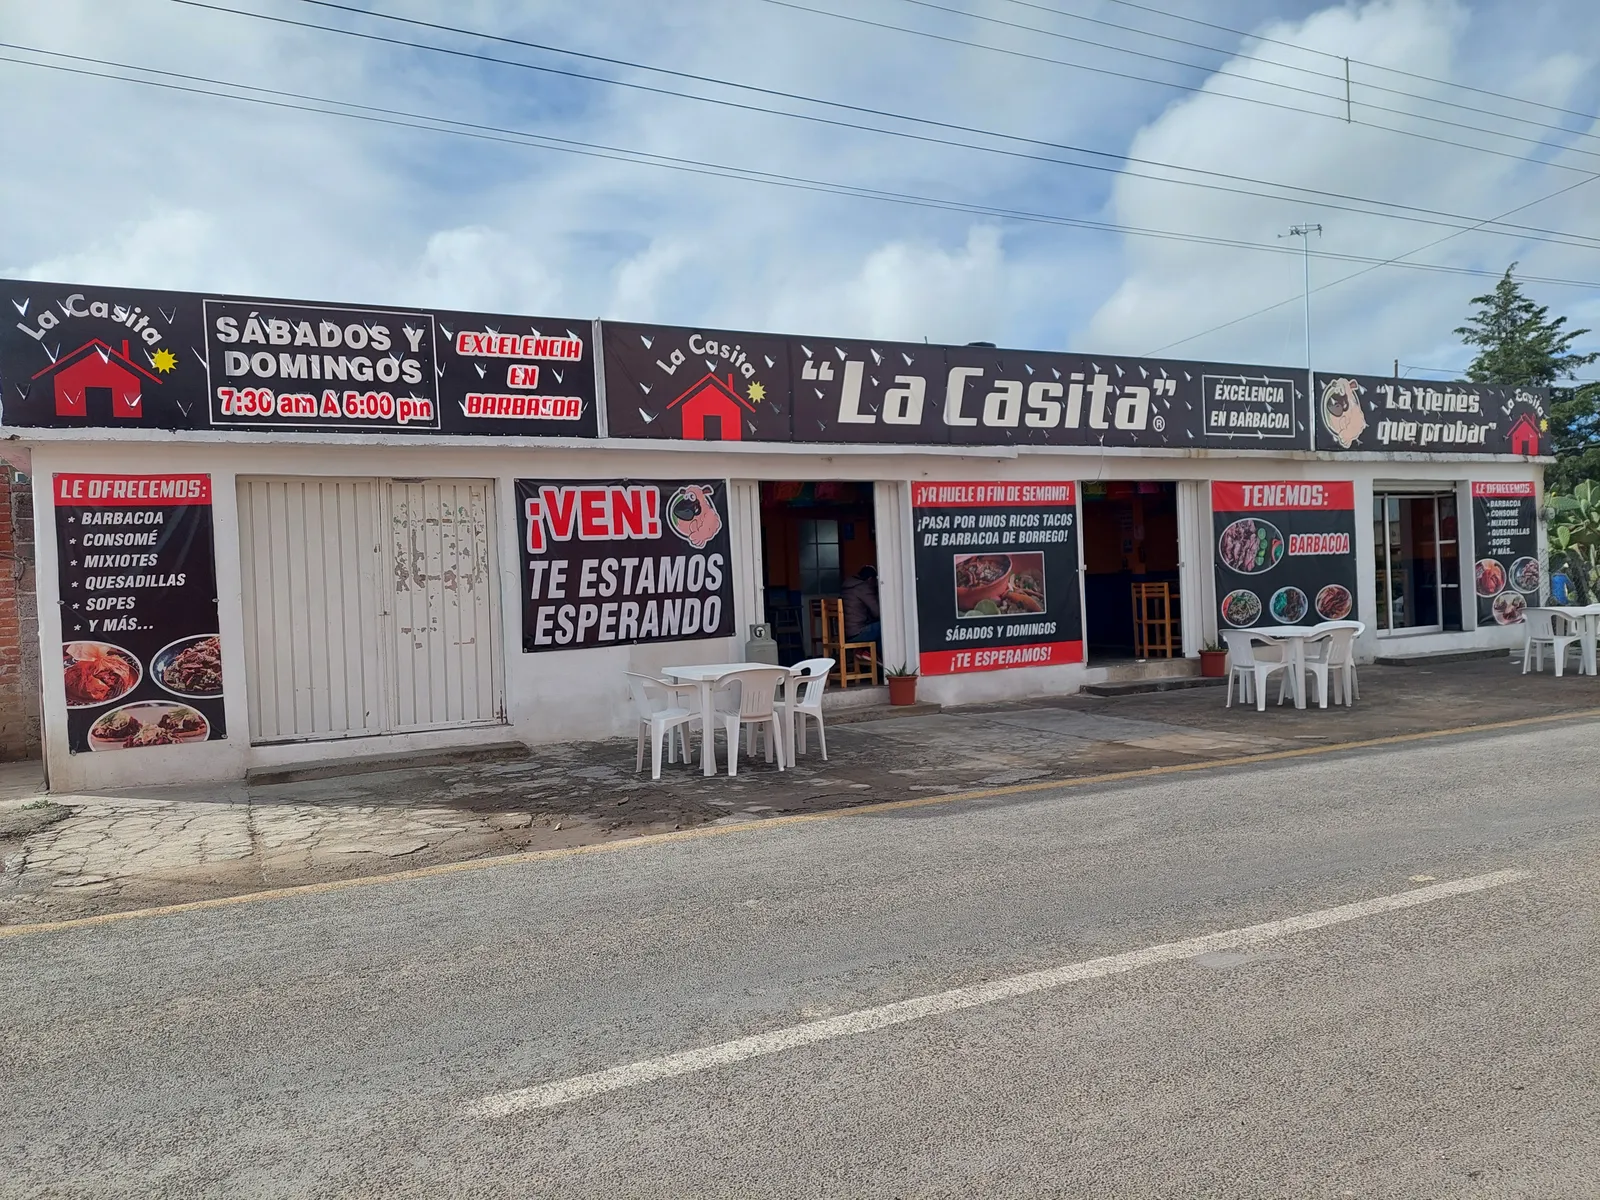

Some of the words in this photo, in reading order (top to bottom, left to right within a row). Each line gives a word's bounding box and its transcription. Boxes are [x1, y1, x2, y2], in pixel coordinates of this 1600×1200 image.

[16, 310, 60, 341] La
[65, 293, 163, 346] Casita
[216, 312, 392, 351] SÁBADOS
[402, 327, 425, 353] Y
[656, 349, 686, 375] La
[689, 334, 756, 379] Casita
[224, 350, 423, 384] DOMINGOS
[508, 366, 538, 387] EN
[1215, 384, 1284, 403] EXCELENCIA
[1416, 387, 1480, 413] tienes
[219, 388, 273, 415] 7:30
[279, 394, 316, 415] am
[321, 390, 340, 416] A
[398, 399, 432, 422] pm
[466, 394, 580, 418] BARBACOA
[1501, 398, 1515, 416] La
[1210, 411, 1227, 426] EN
[1229, 411, 1290, 429] BARBACOA
[1377, 421, 1417, 445] que
[61, 480, 85, 498] LE
[88, 479, 206, 498] OFRECEMOS:
[917, 486, 937, 505] ¡YA
[939, 486, 975, 502] HUELE
[976, 486, 985, 502] A
[987, 486, 1005, 501] FIN
[1007, 486, 1021, 501] DE
[1022, 485, 1070, 501] SEMANA!
[1242, 484, 1329, 507] TENEMOS:
[1476, 483, 1485, 494] LE
[82, 511, 164, 525] BARBACOA
[527, 488, 660, 551] ¡VEN!
[1491, 508, 1519, 517] CONSOMÉ
[917, 515, 950, 532] ¡PASA
[953, 515, 975, 529] POR
[978, 514, 1006, 528] UNOS
[1009, 514, 1040, 527] RICOS
[1042, 513, 1073, 527] TACOS
[1491, 519, 1518, 527] MIXIOTES
[1491, 528, 1530, 536] QUESADILLAS
[83, 529, 158, 547] CONSOMÉ
[924, 533, 939, 547] DE
[941, 531, 999, 546] BARBACOA
[1002, 531, 1016, 544] DE
[1018, 529, 1069, 544] BORREGO!
[1289, 533, 1349, 555] BARBACOA
[1492, 538, 1511, 546] SOPES
[84, 553, 159, 568] MIXIOTES
[85, 573, 187, 591] QUESADILLAS
[529, 559, 569, 600] TE
[578, 553, 724, 598] ESTAMOS
[86, 596, 136, 611] SOPES
[88, 619, 99, 633] Y
[103, 615, 154, 632] MÁS...
[534, 595, 722, 646] ESPERANDO
[945, 625, 994, 642] SÁBADOS
[996, 625, 1004, 638] Y
[1006, 621, 1057, 637] DOMINGOS
[950, 653, 971, 671] ¡TE
[974, 646, 1052, 667] ESPERAMOS!
